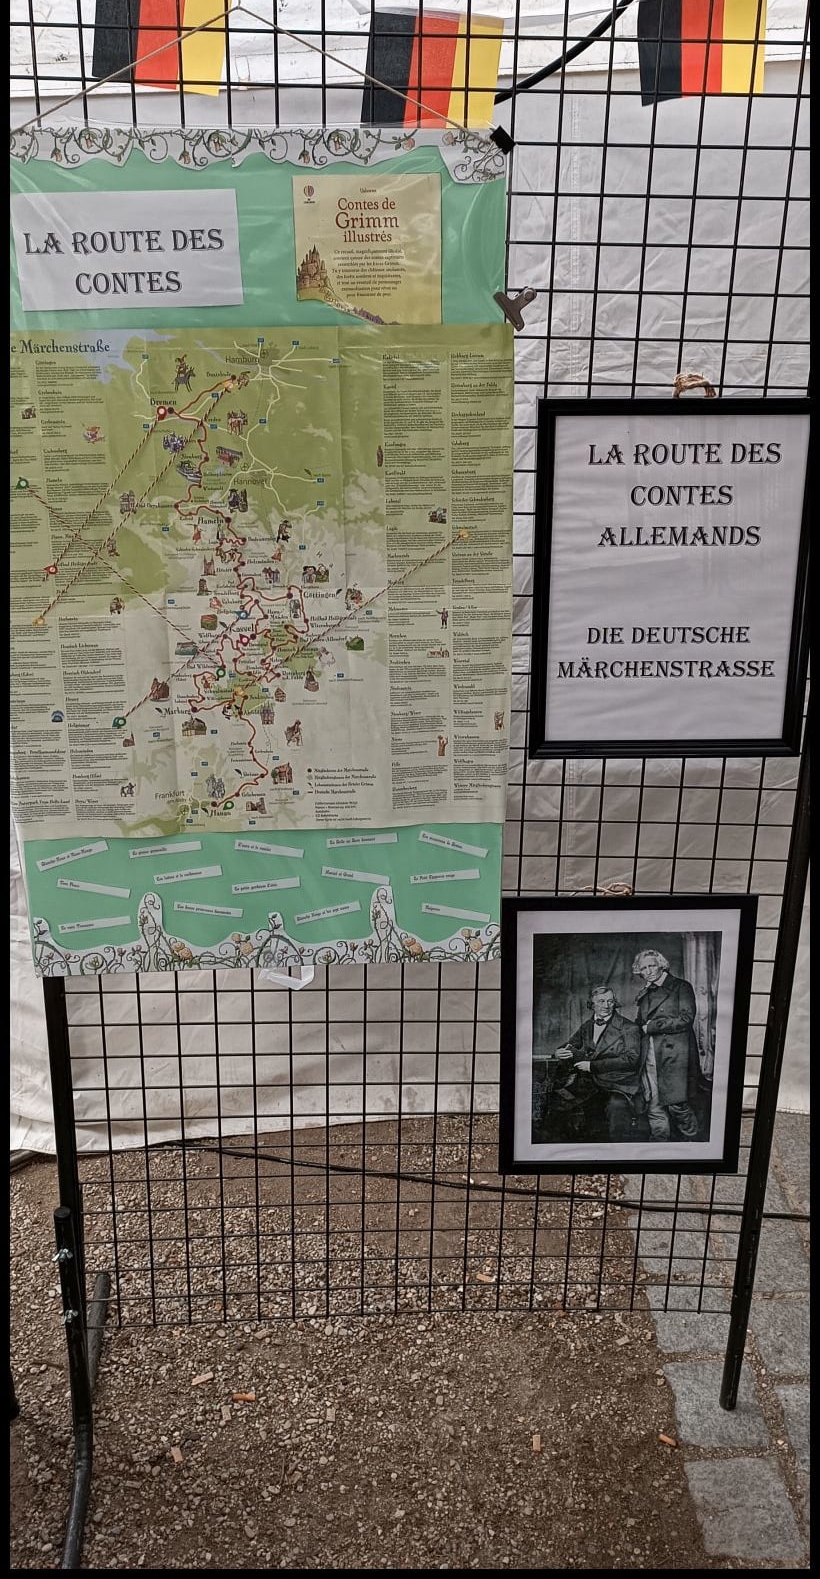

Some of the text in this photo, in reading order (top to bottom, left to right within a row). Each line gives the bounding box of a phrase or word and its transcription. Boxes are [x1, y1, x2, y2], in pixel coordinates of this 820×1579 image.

[338, 197, 396, 210] Contes de
[335, 212, 399, 229] Grimm
[23, 229, 224, 255] LA ROUTE DES
[344, 231, 392, 242] illustrés
[76, 271, 182, 294] CONTES
[20, 339, 110, 354] Märchenstraße
[225, 355, 259, 364] Hamburg
[588, 443, 783, 466] LA ROUTE DES
[630, 485, 734, 506] CONTES
[597, 526, 761, 547] ALLEMANDS
[587, 626, 751, 645] DIE DEUTSCHE
[556, 656, 776, 679] MÄRCHENSTRASSE
[154, 790, 185, 800] Frankfurt
